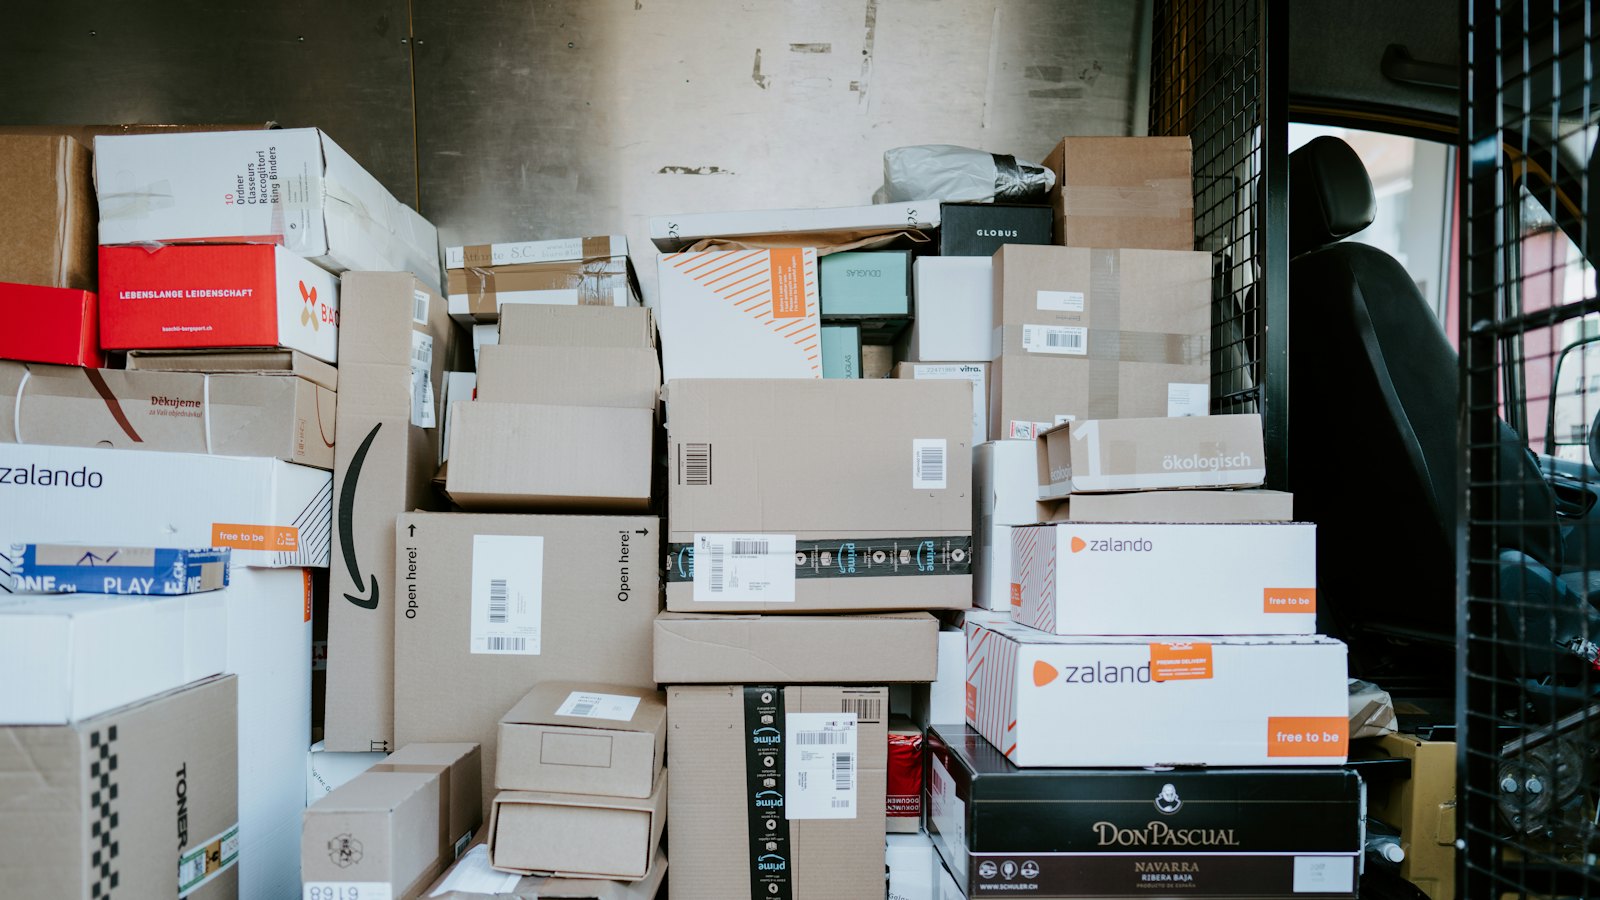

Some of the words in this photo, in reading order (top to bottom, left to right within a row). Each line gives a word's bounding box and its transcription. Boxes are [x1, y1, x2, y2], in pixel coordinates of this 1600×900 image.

[268, 146, 278, 180] Binders
[248, 162, 256, 205] Classeurs
[256, 150, 268, 204] Raccoglitori
[236, 174, 245, 205] Ordner
[270, 183, 280, 204] Ring
[225, 193, 234, 205] 10
[976, 229, 1018, 238] GLOBUS
[846, 269, 882, 278] DOUGLAS
[119, 289, 184, 300] LEBENSLANGE
[185, 288, 253, 299] LEIDENSCHAFT
[151, 396, 201, 409] Děkujeme
[1163, 452, 1251, 472] ökologisch
[0, 463, 103, 489] zalando
[220, 531, 238, 541] free
[240, 532, 250, 541] to
[252, 533, 264, 542] be
[1090, 537, 1153, 552] zalando
[618, 530, 630, 563] here!
[406, 547, 417, 580] here!
[846, 543, 857, 573] prime
[925, 540, 936, 572] prime
[103, 577, 154, 594] PLAY
[617, 567, 631, 602] Open
[405, 584, 419, 619] Open
[1269, 596, 1286, 605] free
[1288, 597, 1297, 605] to
[1298, 596, 1310, 605] be
[1065, 661, 1165, 683] zaland
[753, 734, 781, 745] prime
[1276, 731, 1303, 743] free
[1306, 732, 1319, 743] to
[1322, 731, 1339, 743] be
[176, 761, 188, 852] TONER
[756, 797, 783, 809] prime
[758, 860, 786, 872] prime
[1135, 862, 1199, 873] NAVARRA
[1173, 874, 1193, 882] BAJA
[980, 883, 1039, 891] WWW.SCHULER.CH
